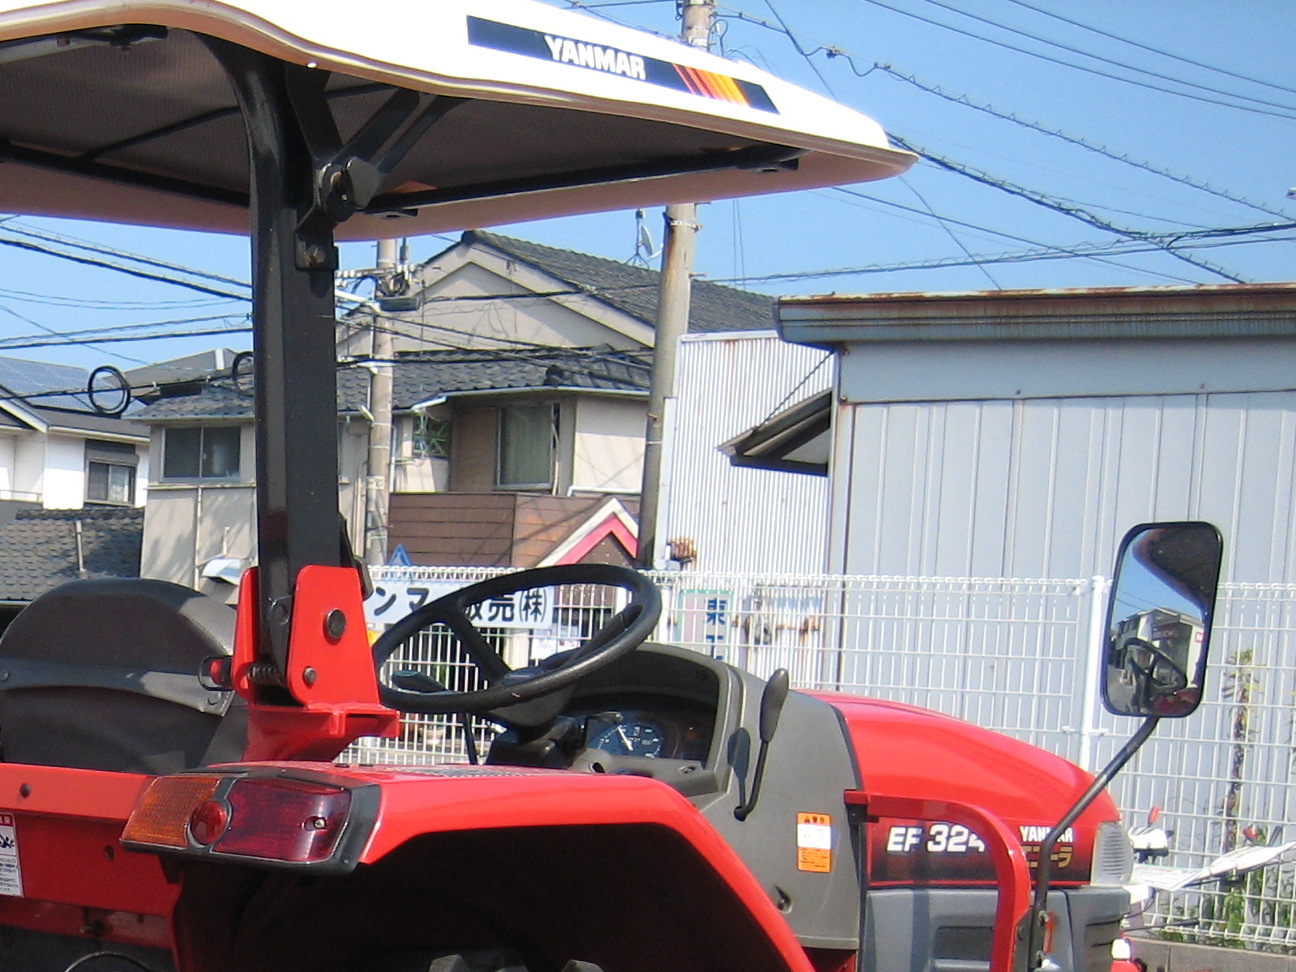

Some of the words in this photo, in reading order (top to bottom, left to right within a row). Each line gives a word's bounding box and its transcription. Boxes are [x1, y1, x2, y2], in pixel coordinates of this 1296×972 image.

[544, 34, 647, 81] YANMAR
[886, 826, 923, 852] EF
[1018, 825, 1073, 843] YANAR
